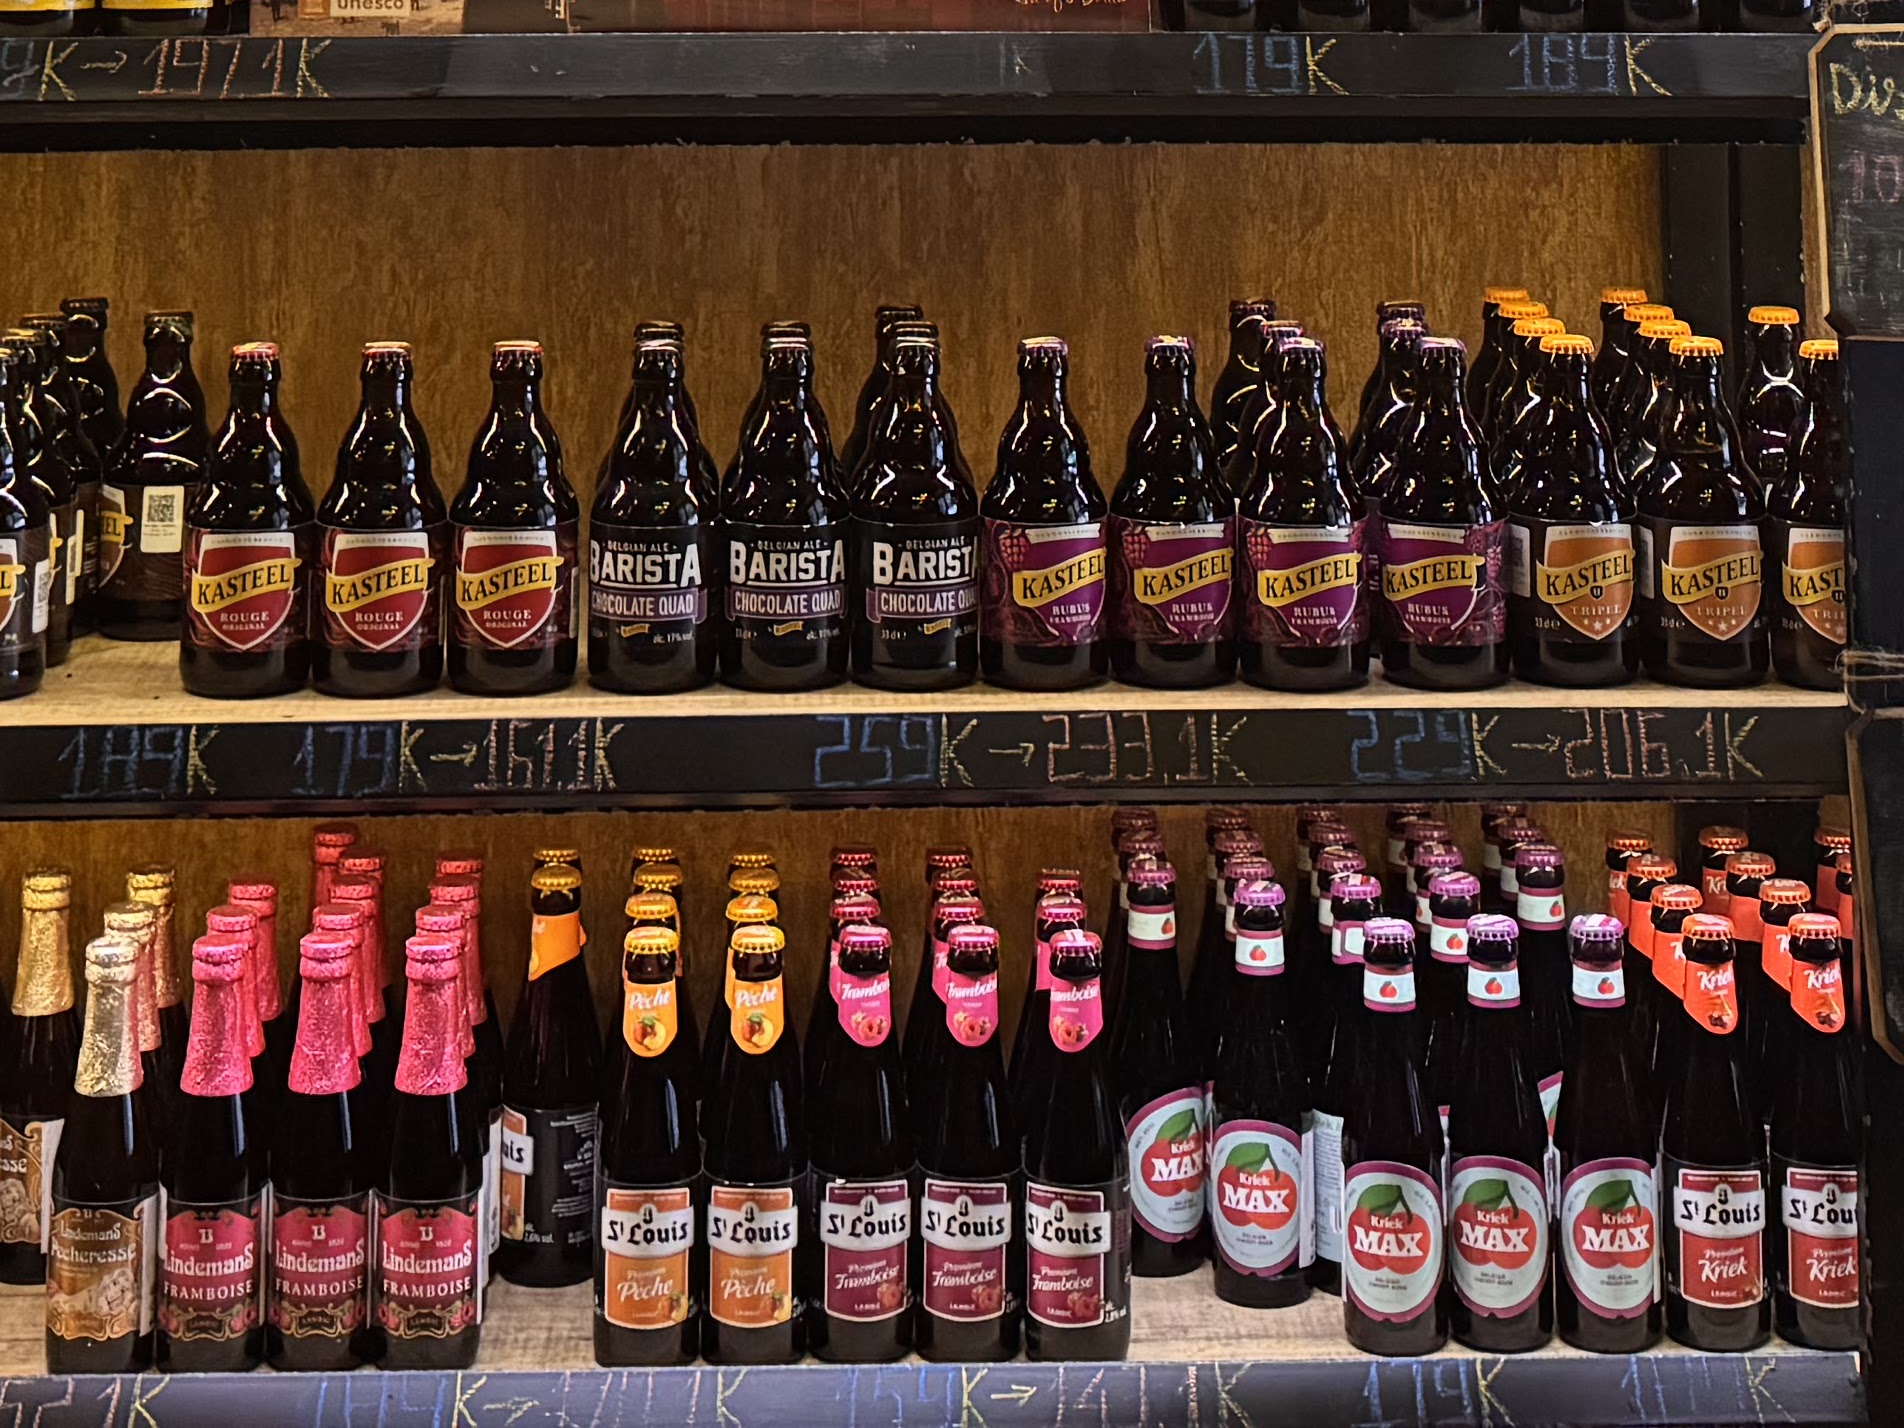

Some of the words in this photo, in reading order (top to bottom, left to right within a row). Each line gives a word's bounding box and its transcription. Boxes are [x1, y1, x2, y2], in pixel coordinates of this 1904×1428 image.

[730, 542, 846, 587] BARISTA
[1545, 555, 1633, 595] KASTEEL
[196, 562, 292, 603] KASTEEL
[220, 609, 270, 623] ROUGE
[734, 594, 808, 615] CHOCOLATE
[811, 592, 842, 615] QUAD
[1354, 1230, 1423, 1255] MAX
[383, 1278, 471, 1298] FRAMBOISE
